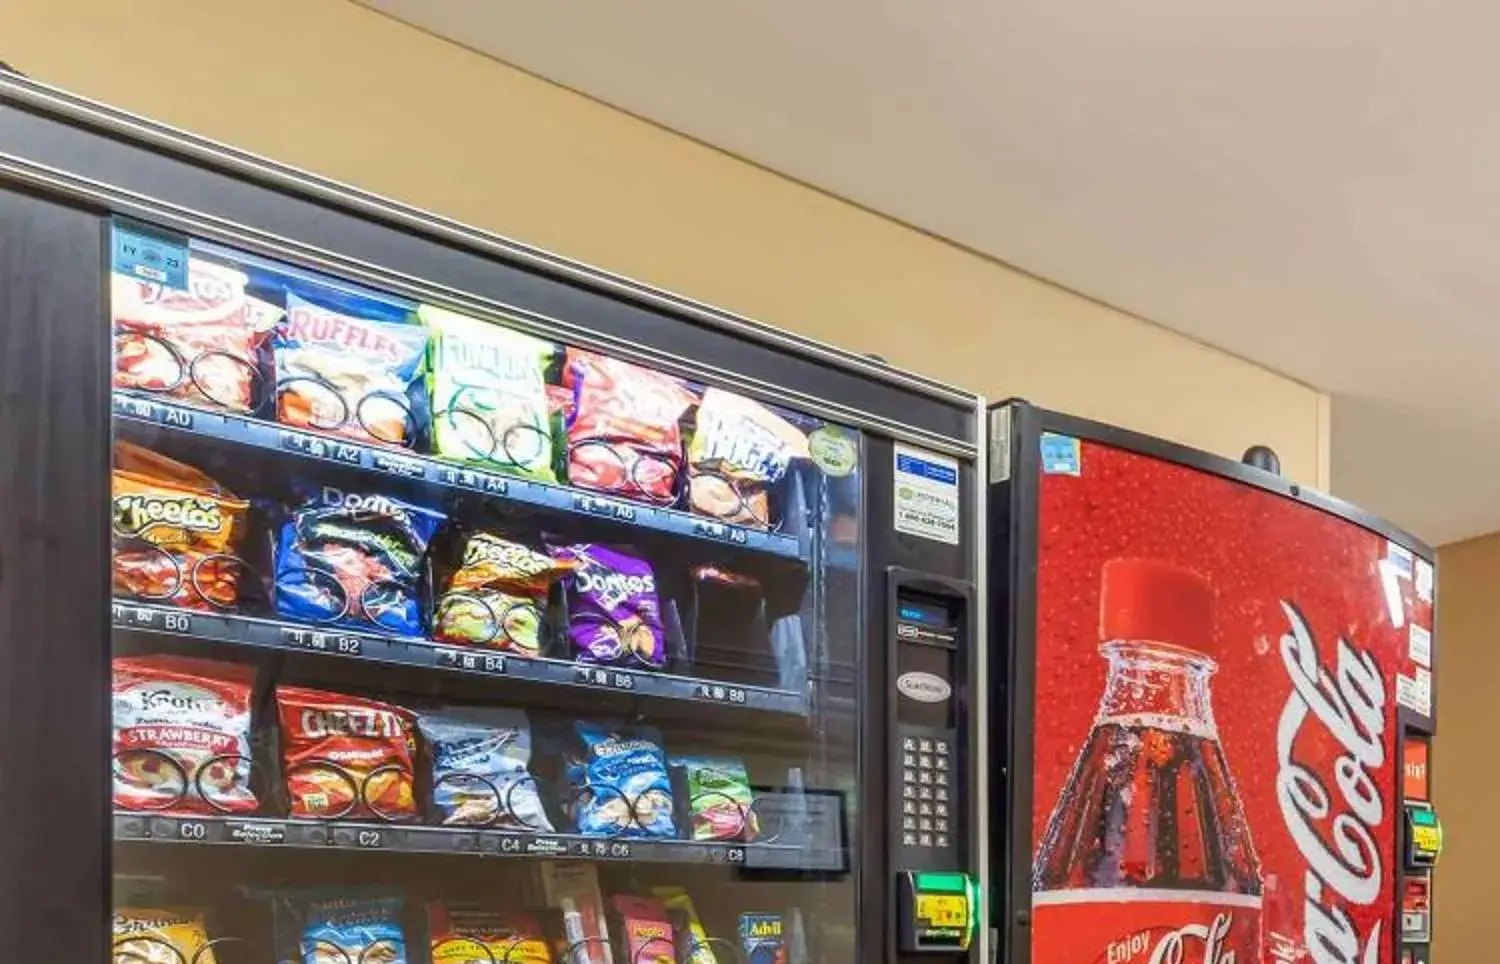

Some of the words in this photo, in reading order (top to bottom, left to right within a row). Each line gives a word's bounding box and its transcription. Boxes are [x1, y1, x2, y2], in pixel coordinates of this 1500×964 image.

[290, 310, 402, 359] RUFFLES
[337, 447, 358, 462] A2
[576, 571, 656, 594] Doritos
[165, 614, 189, 631] B0
[338, 637, 359, 654] B2
[485, 655, 503, 671] B4
[128, 728, 231, 747] STRAWBERRY
[181, 823, 205, 838] C0
[358, 831, 380, 847] C2
[501, 839, 520, 851] C4
[611, 843, 629, 857] C6
[749, 921, 781, 936] Advil
